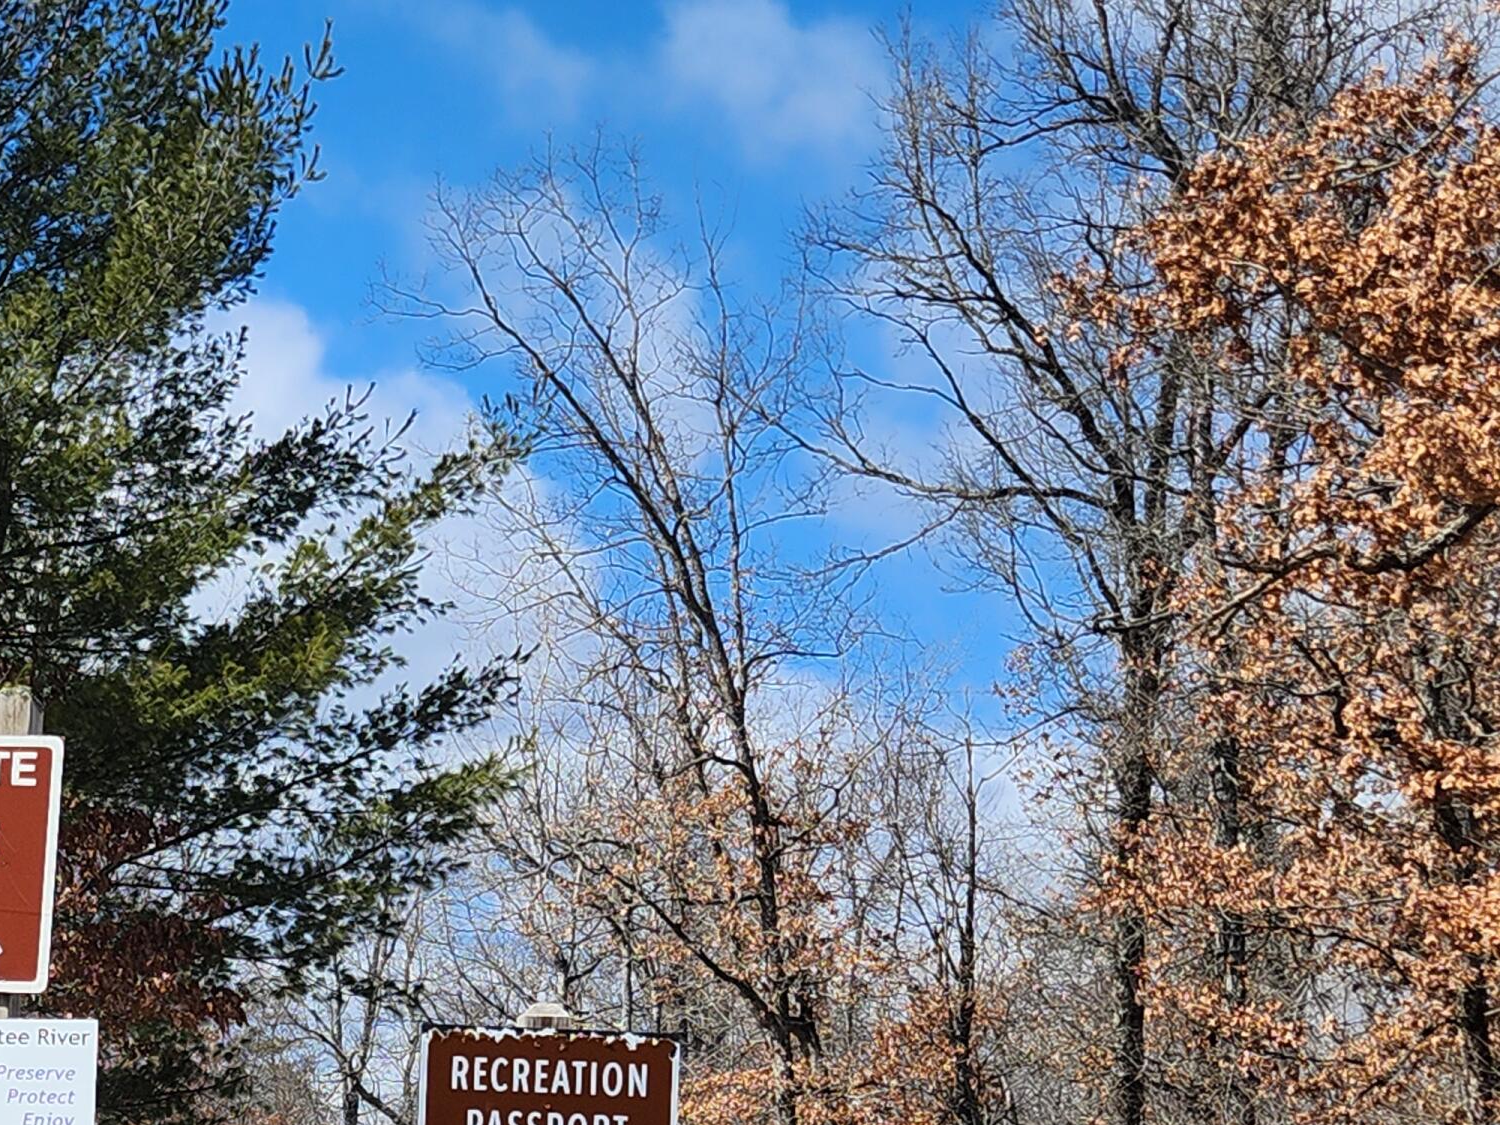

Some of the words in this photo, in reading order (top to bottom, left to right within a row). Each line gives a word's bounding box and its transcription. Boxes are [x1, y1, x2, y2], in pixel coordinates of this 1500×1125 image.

[37, 1028, 90, 1046] River
[451, 1055, 648, 1098] RECREATION
[6, 1088, 76, 1105] Protect
